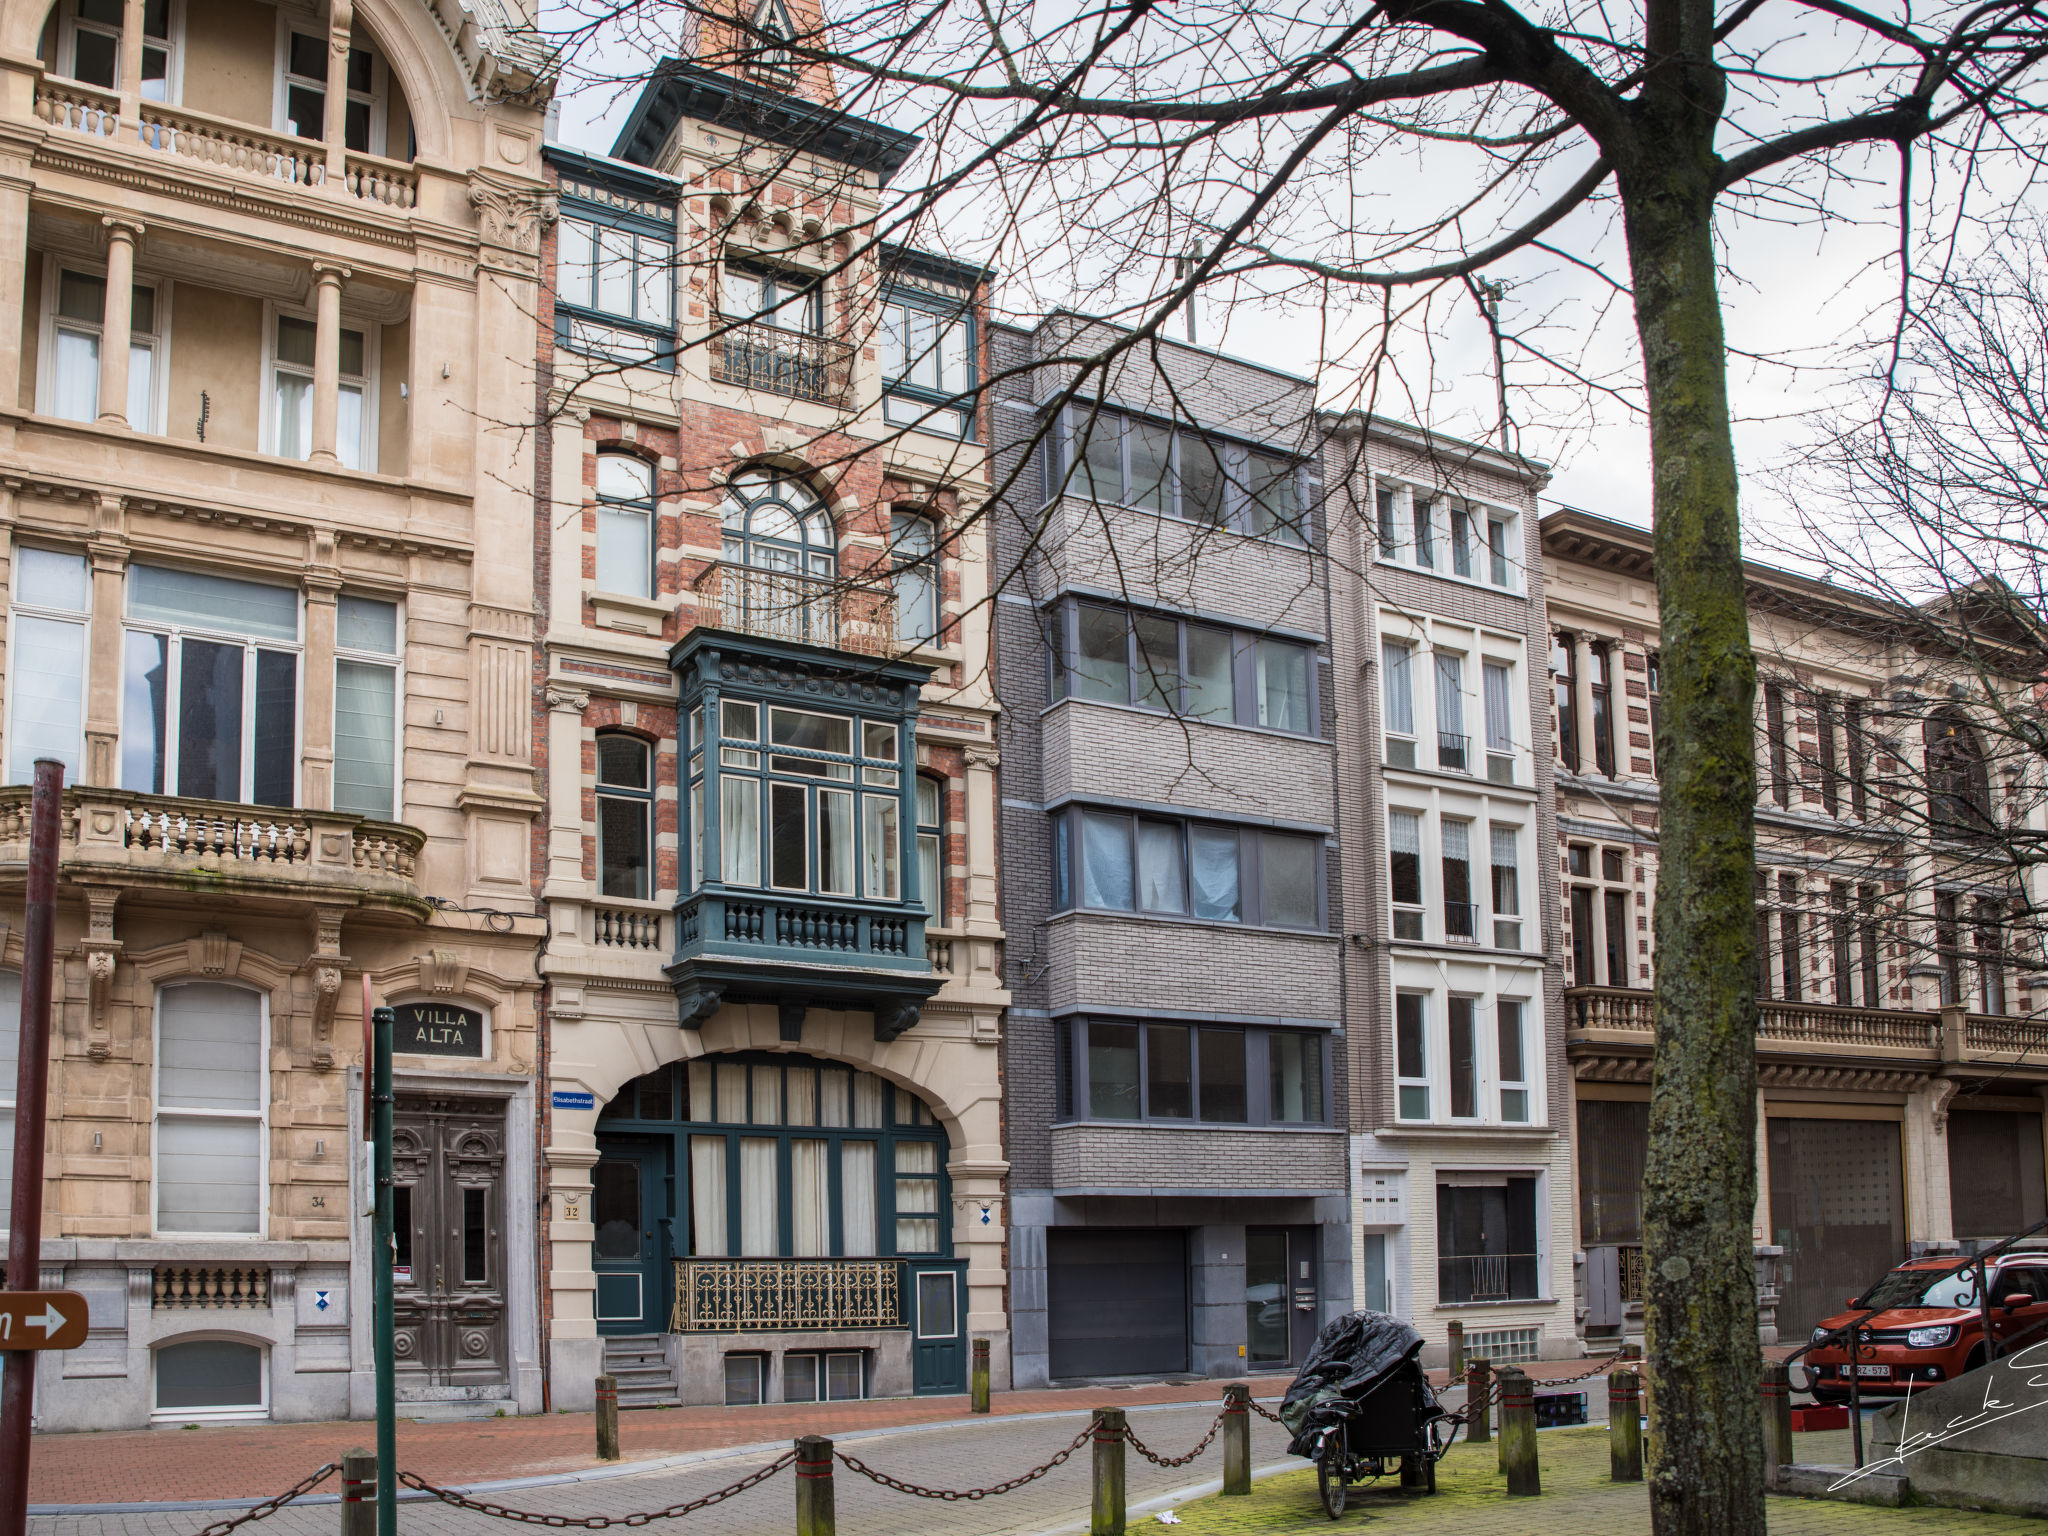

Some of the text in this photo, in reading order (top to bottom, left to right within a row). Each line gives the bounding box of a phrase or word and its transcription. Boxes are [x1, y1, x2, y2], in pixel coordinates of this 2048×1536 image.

[414, 1009, 467, 1026] VILLA
[415, 1027, 464, 1045] ALTA
[553, 1096, 593, 1105] Elisabethstraat
[312, 1196, 325, 1208] 34
[566, 1207, 578, 1217] 32
[1843, 1366, 1889, 1376] 1RZ-573
